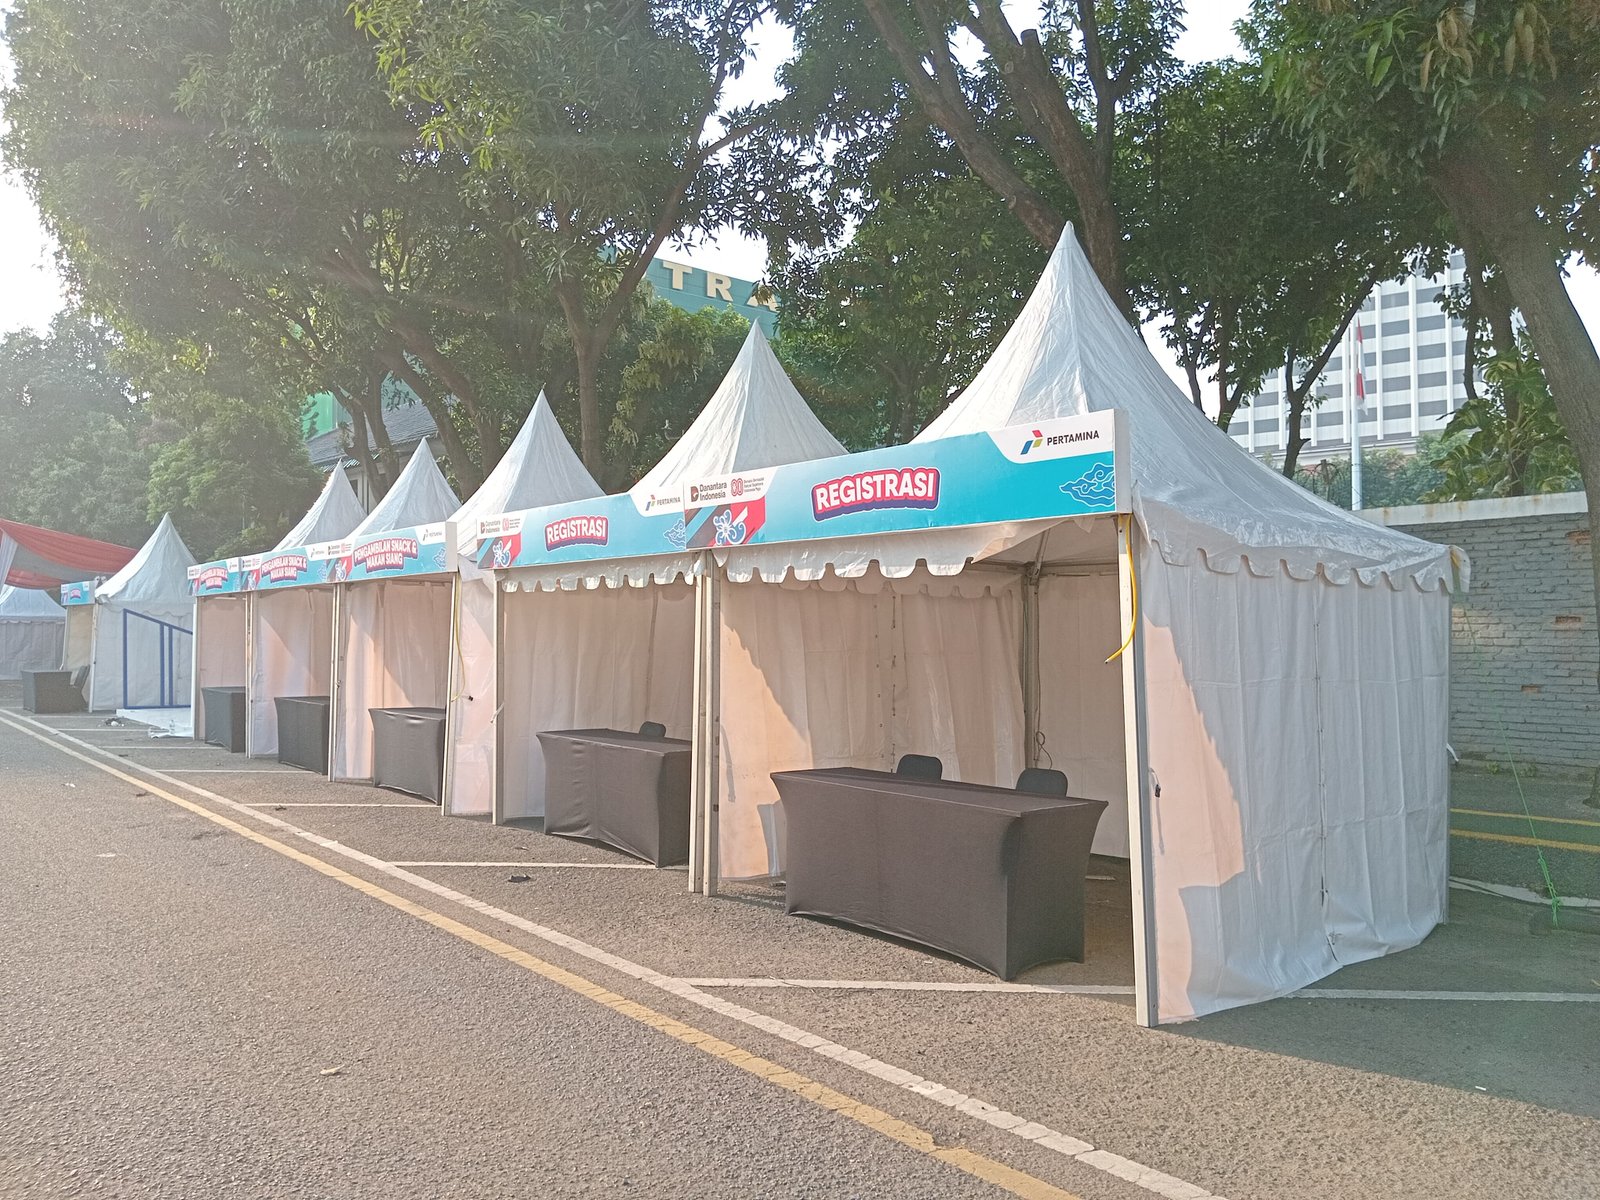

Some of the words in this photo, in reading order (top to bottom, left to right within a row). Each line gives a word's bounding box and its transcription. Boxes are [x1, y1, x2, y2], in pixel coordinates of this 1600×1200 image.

[1047, 430, 1100, 446] PERTAMINA
[700, 482, 727, 492] Danantara
[816, 472, 935, 511] REGISTRASI
[700, 491, 726, 500] Indonesia
[547, 519, 606, 544] REGISTRASI
[354, 541, 391, 562] PENGAMBILAN
[391, 540, 411, 554] SNACK
[366, 553, 385, 568] MAKAN
[385, 553, 402, 565] SIANG
